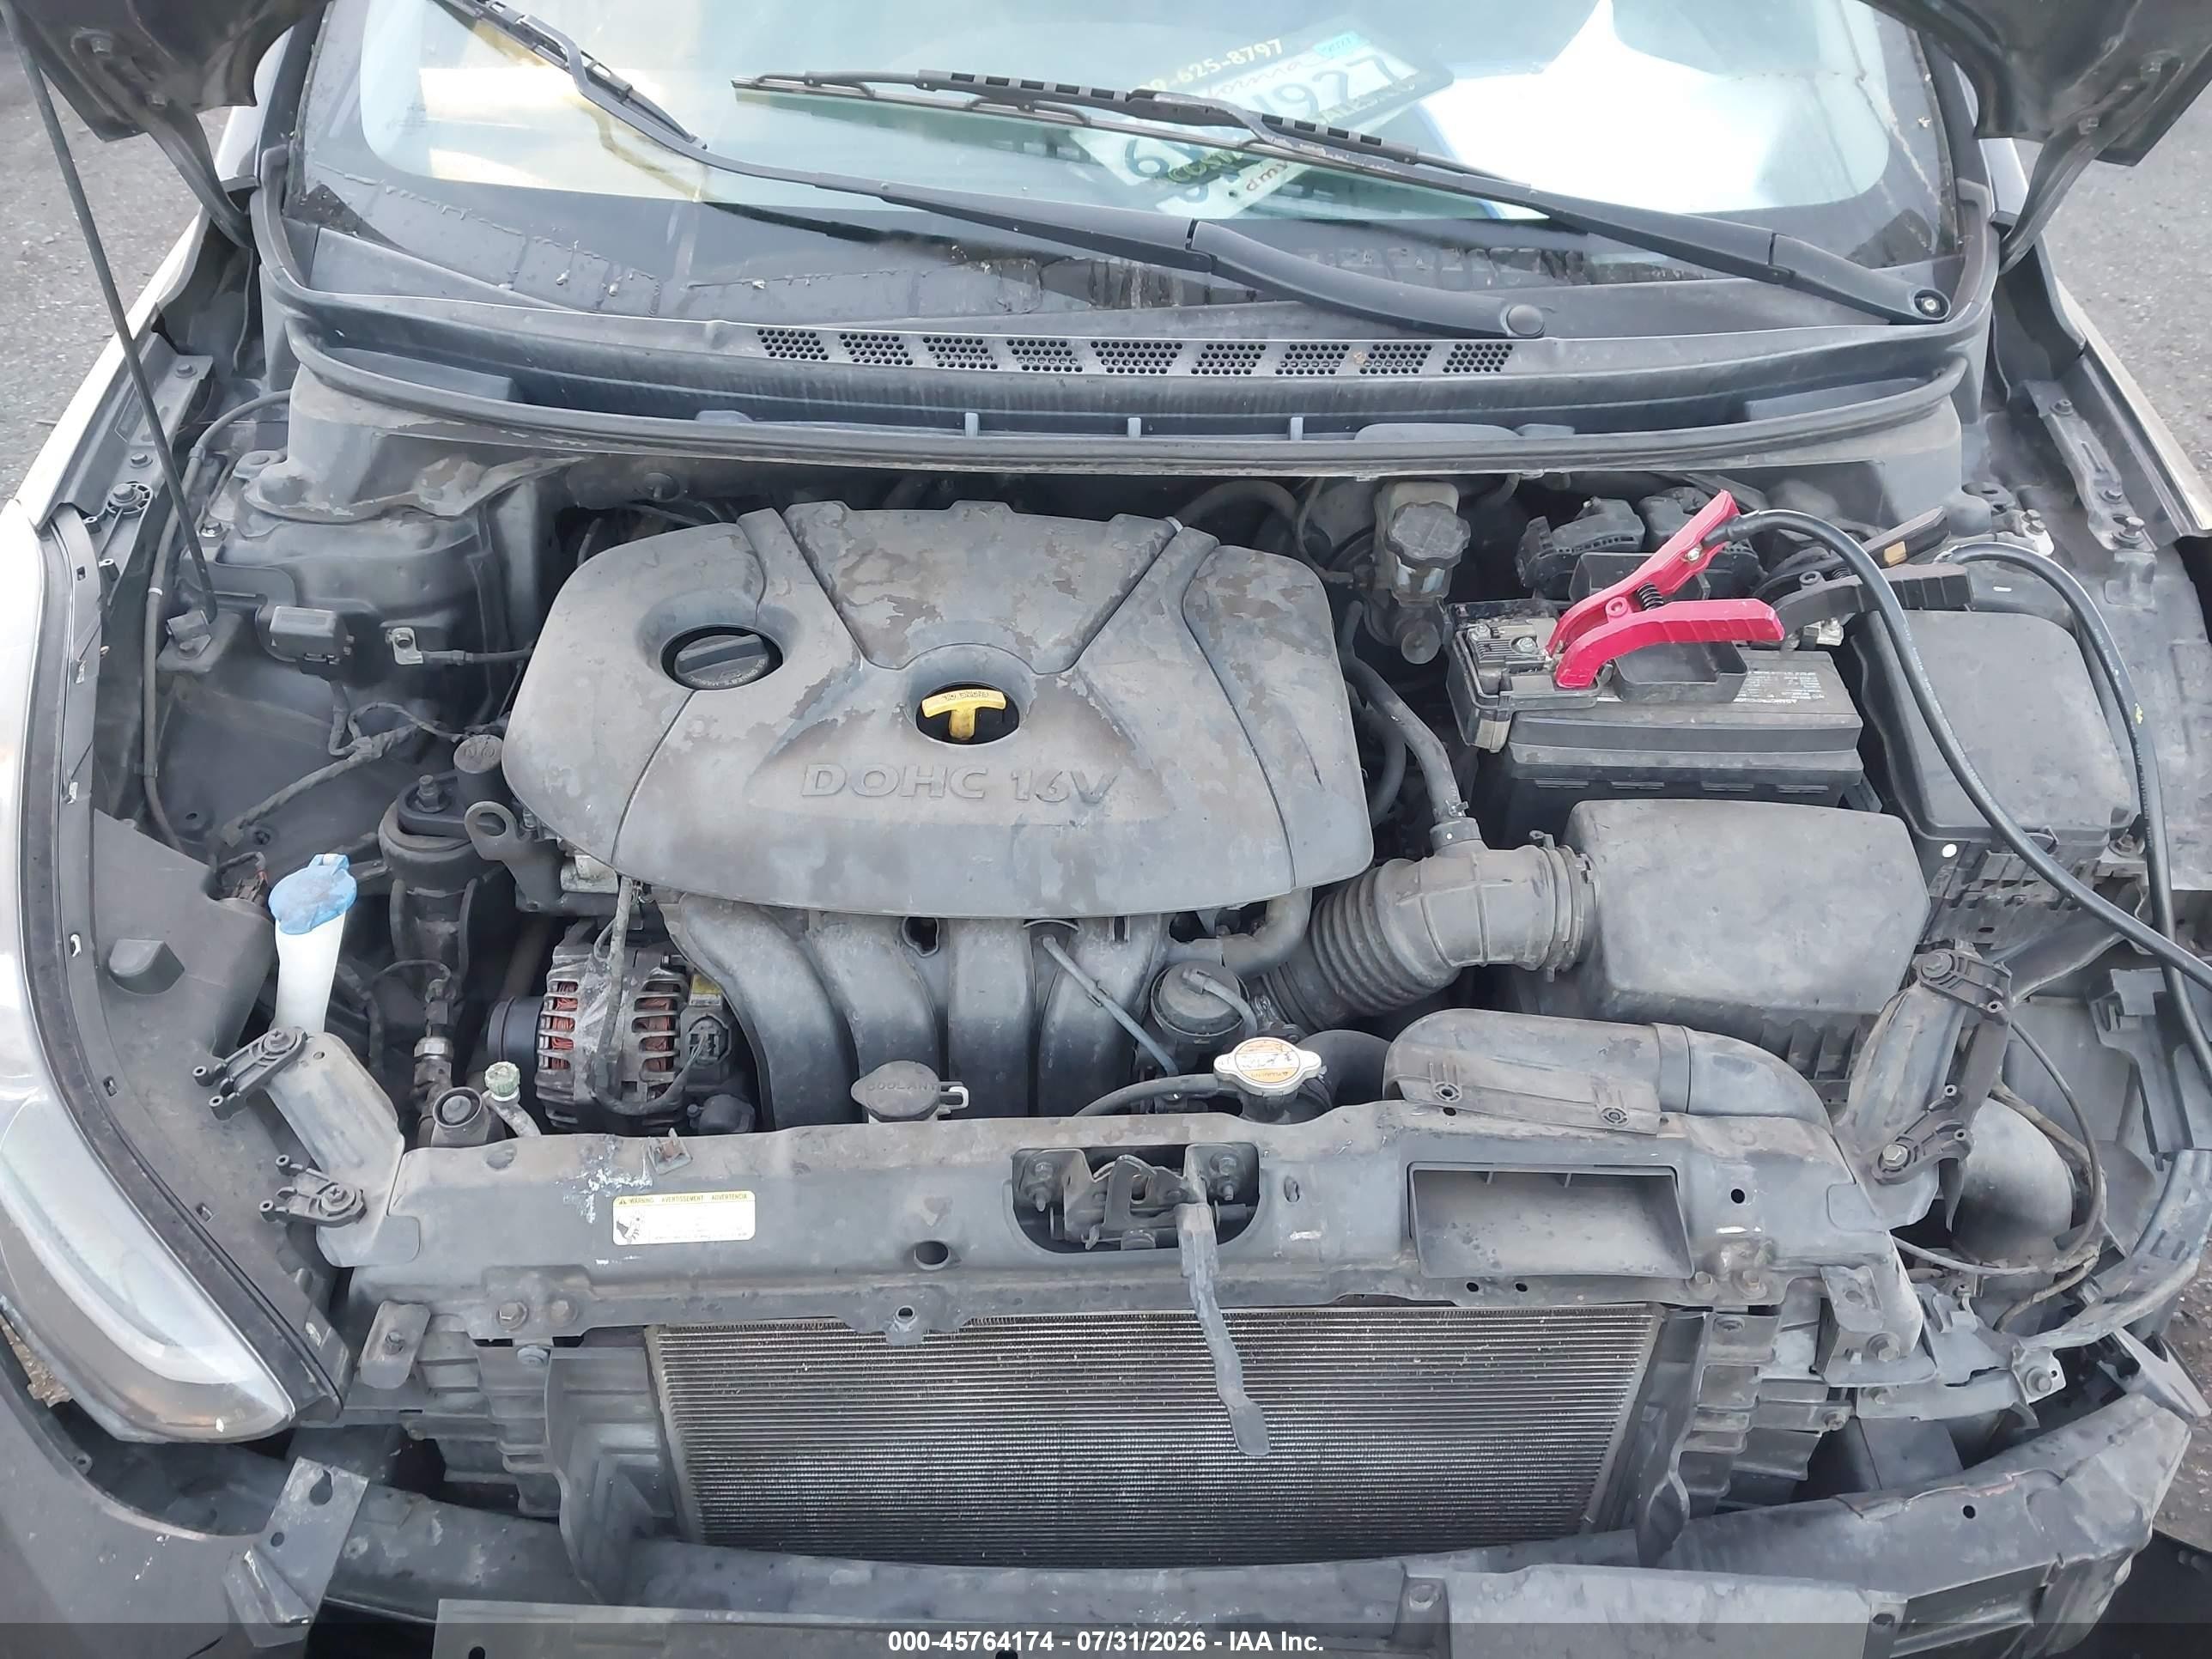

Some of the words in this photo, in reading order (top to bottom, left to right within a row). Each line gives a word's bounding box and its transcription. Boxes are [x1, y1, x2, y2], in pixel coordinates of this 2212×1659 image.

[801, 763, 988, 800] DOHC
[1011, 769, 1119, 805] 16V
[866, 1081, 936, 1092] COOLANT
